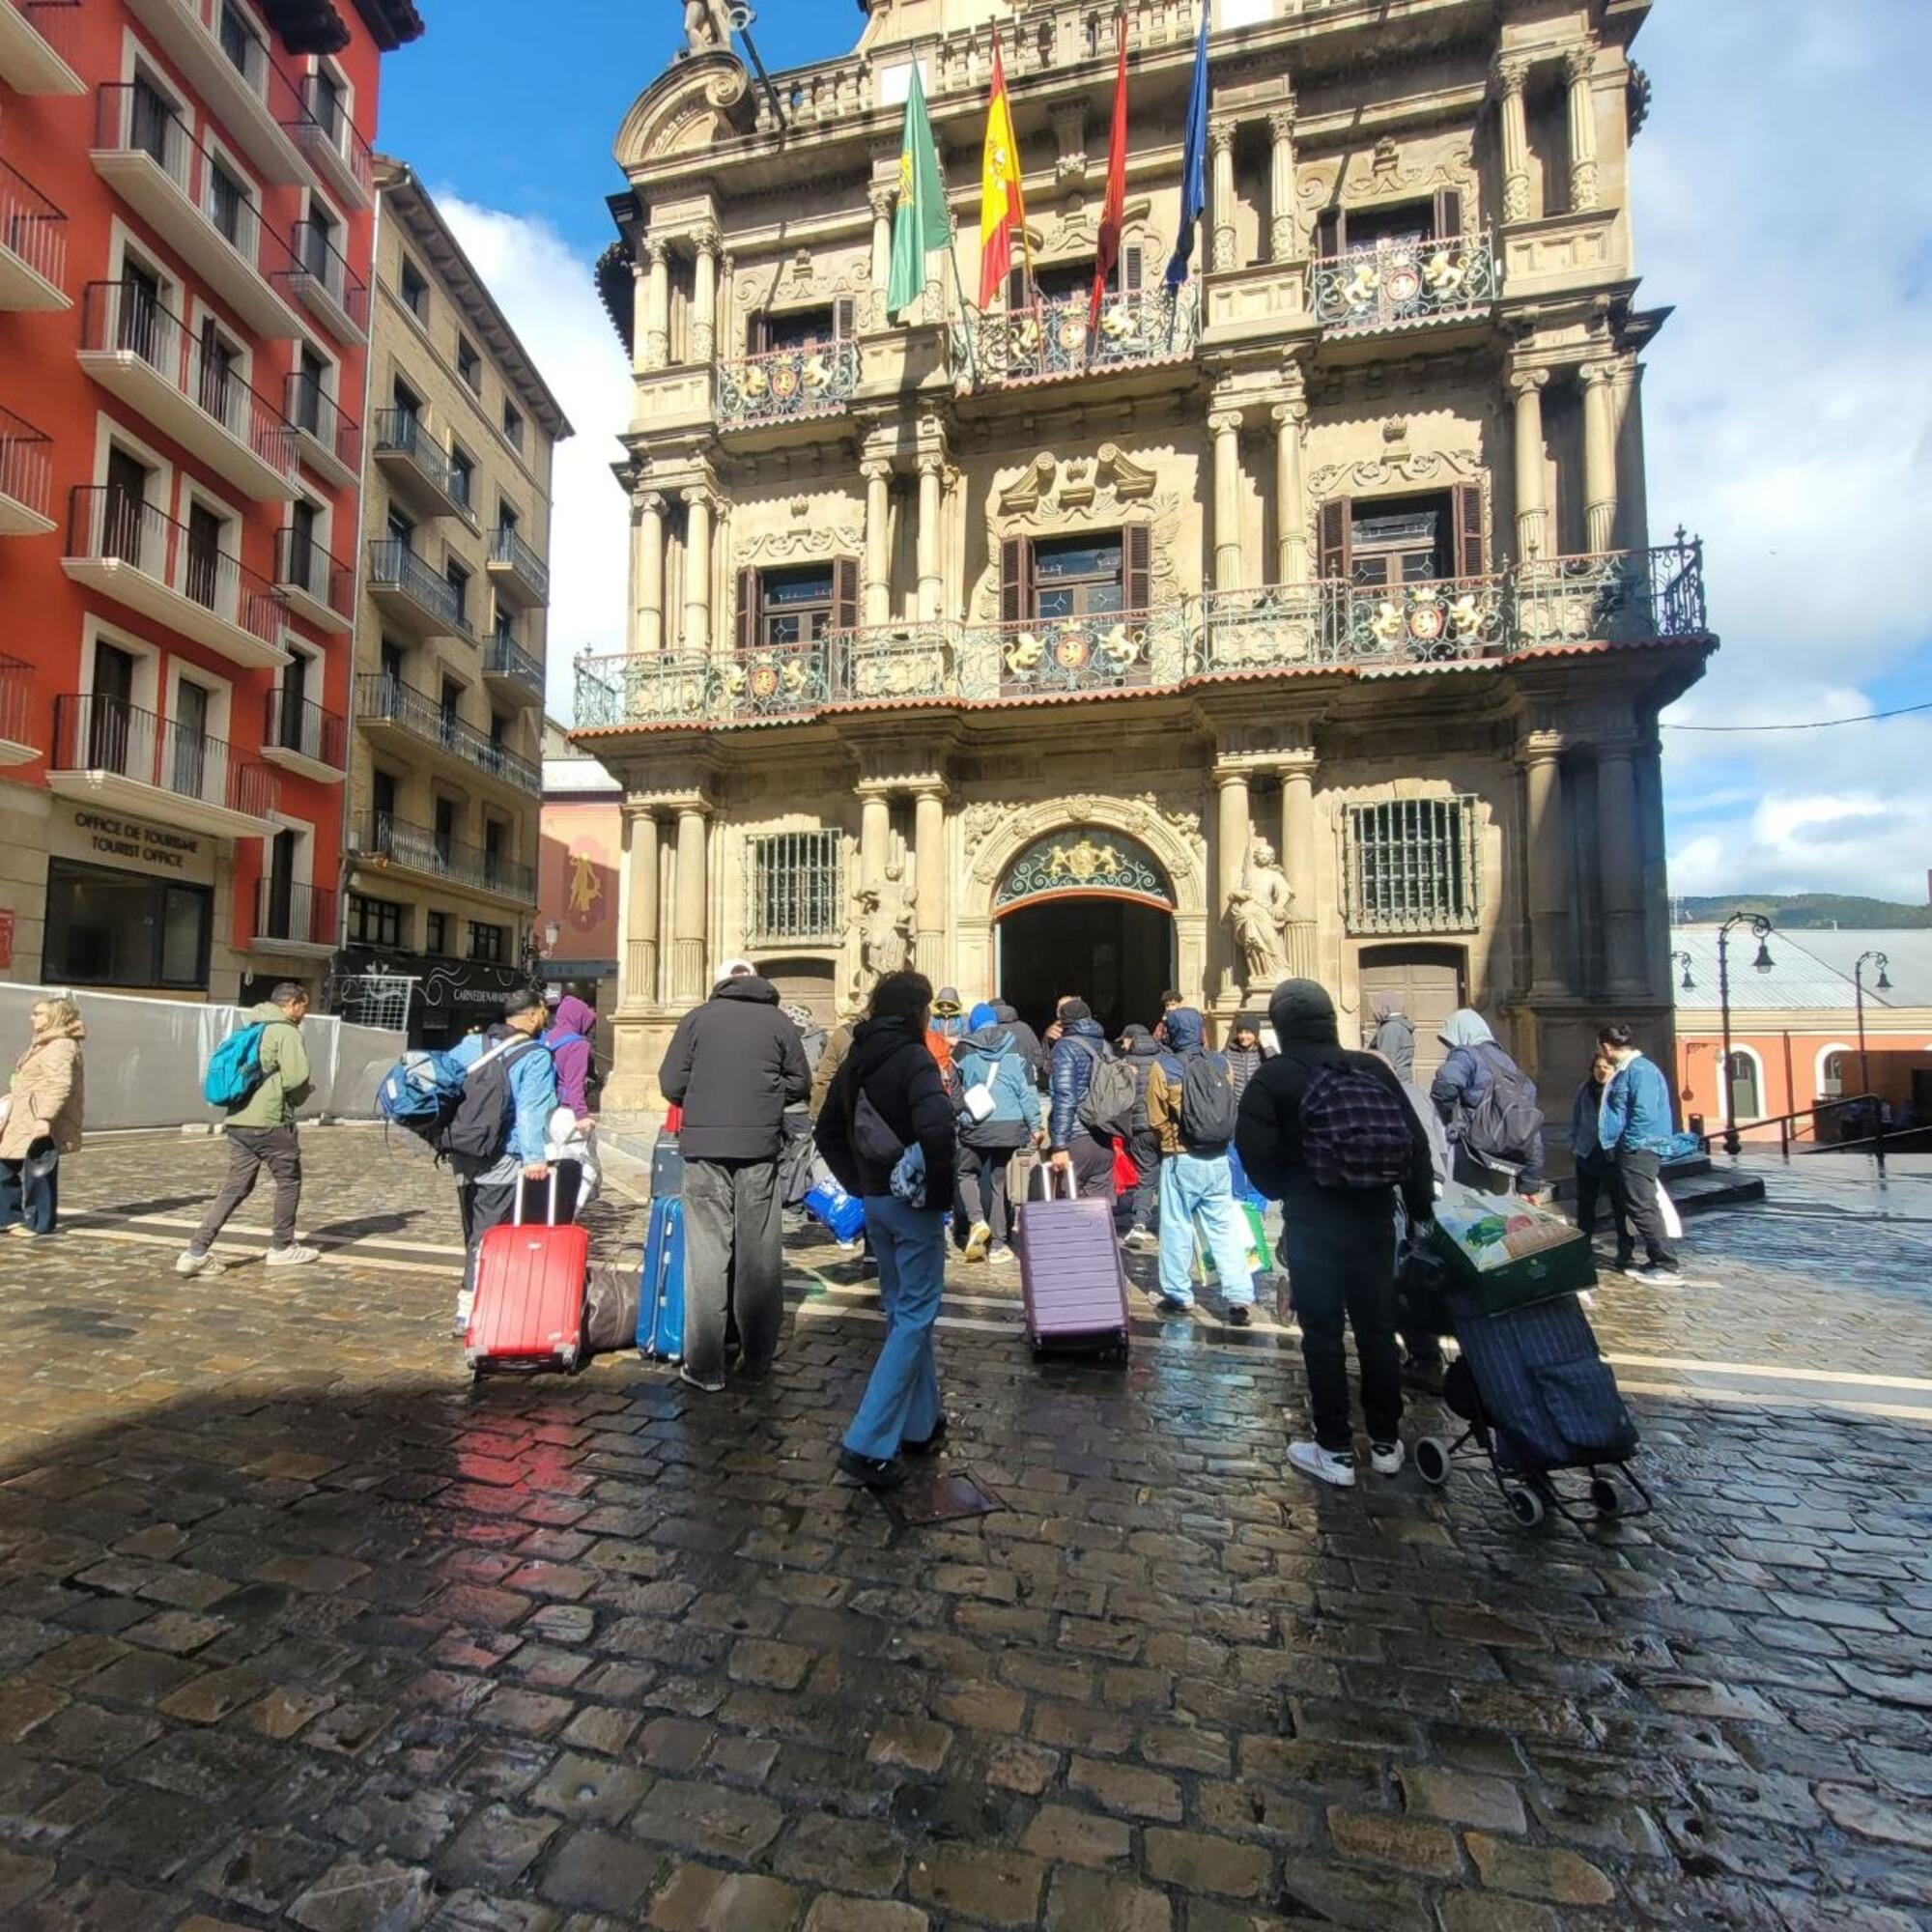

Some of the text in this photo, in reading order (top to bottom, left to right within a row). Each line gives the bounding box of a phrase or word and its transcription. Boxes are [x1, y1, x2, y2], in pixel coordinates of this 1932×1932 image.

[75, 812, 197, 853] OFFICE DE TOURISME
[92, 836, 183, 867] TOURIST OFFICE
